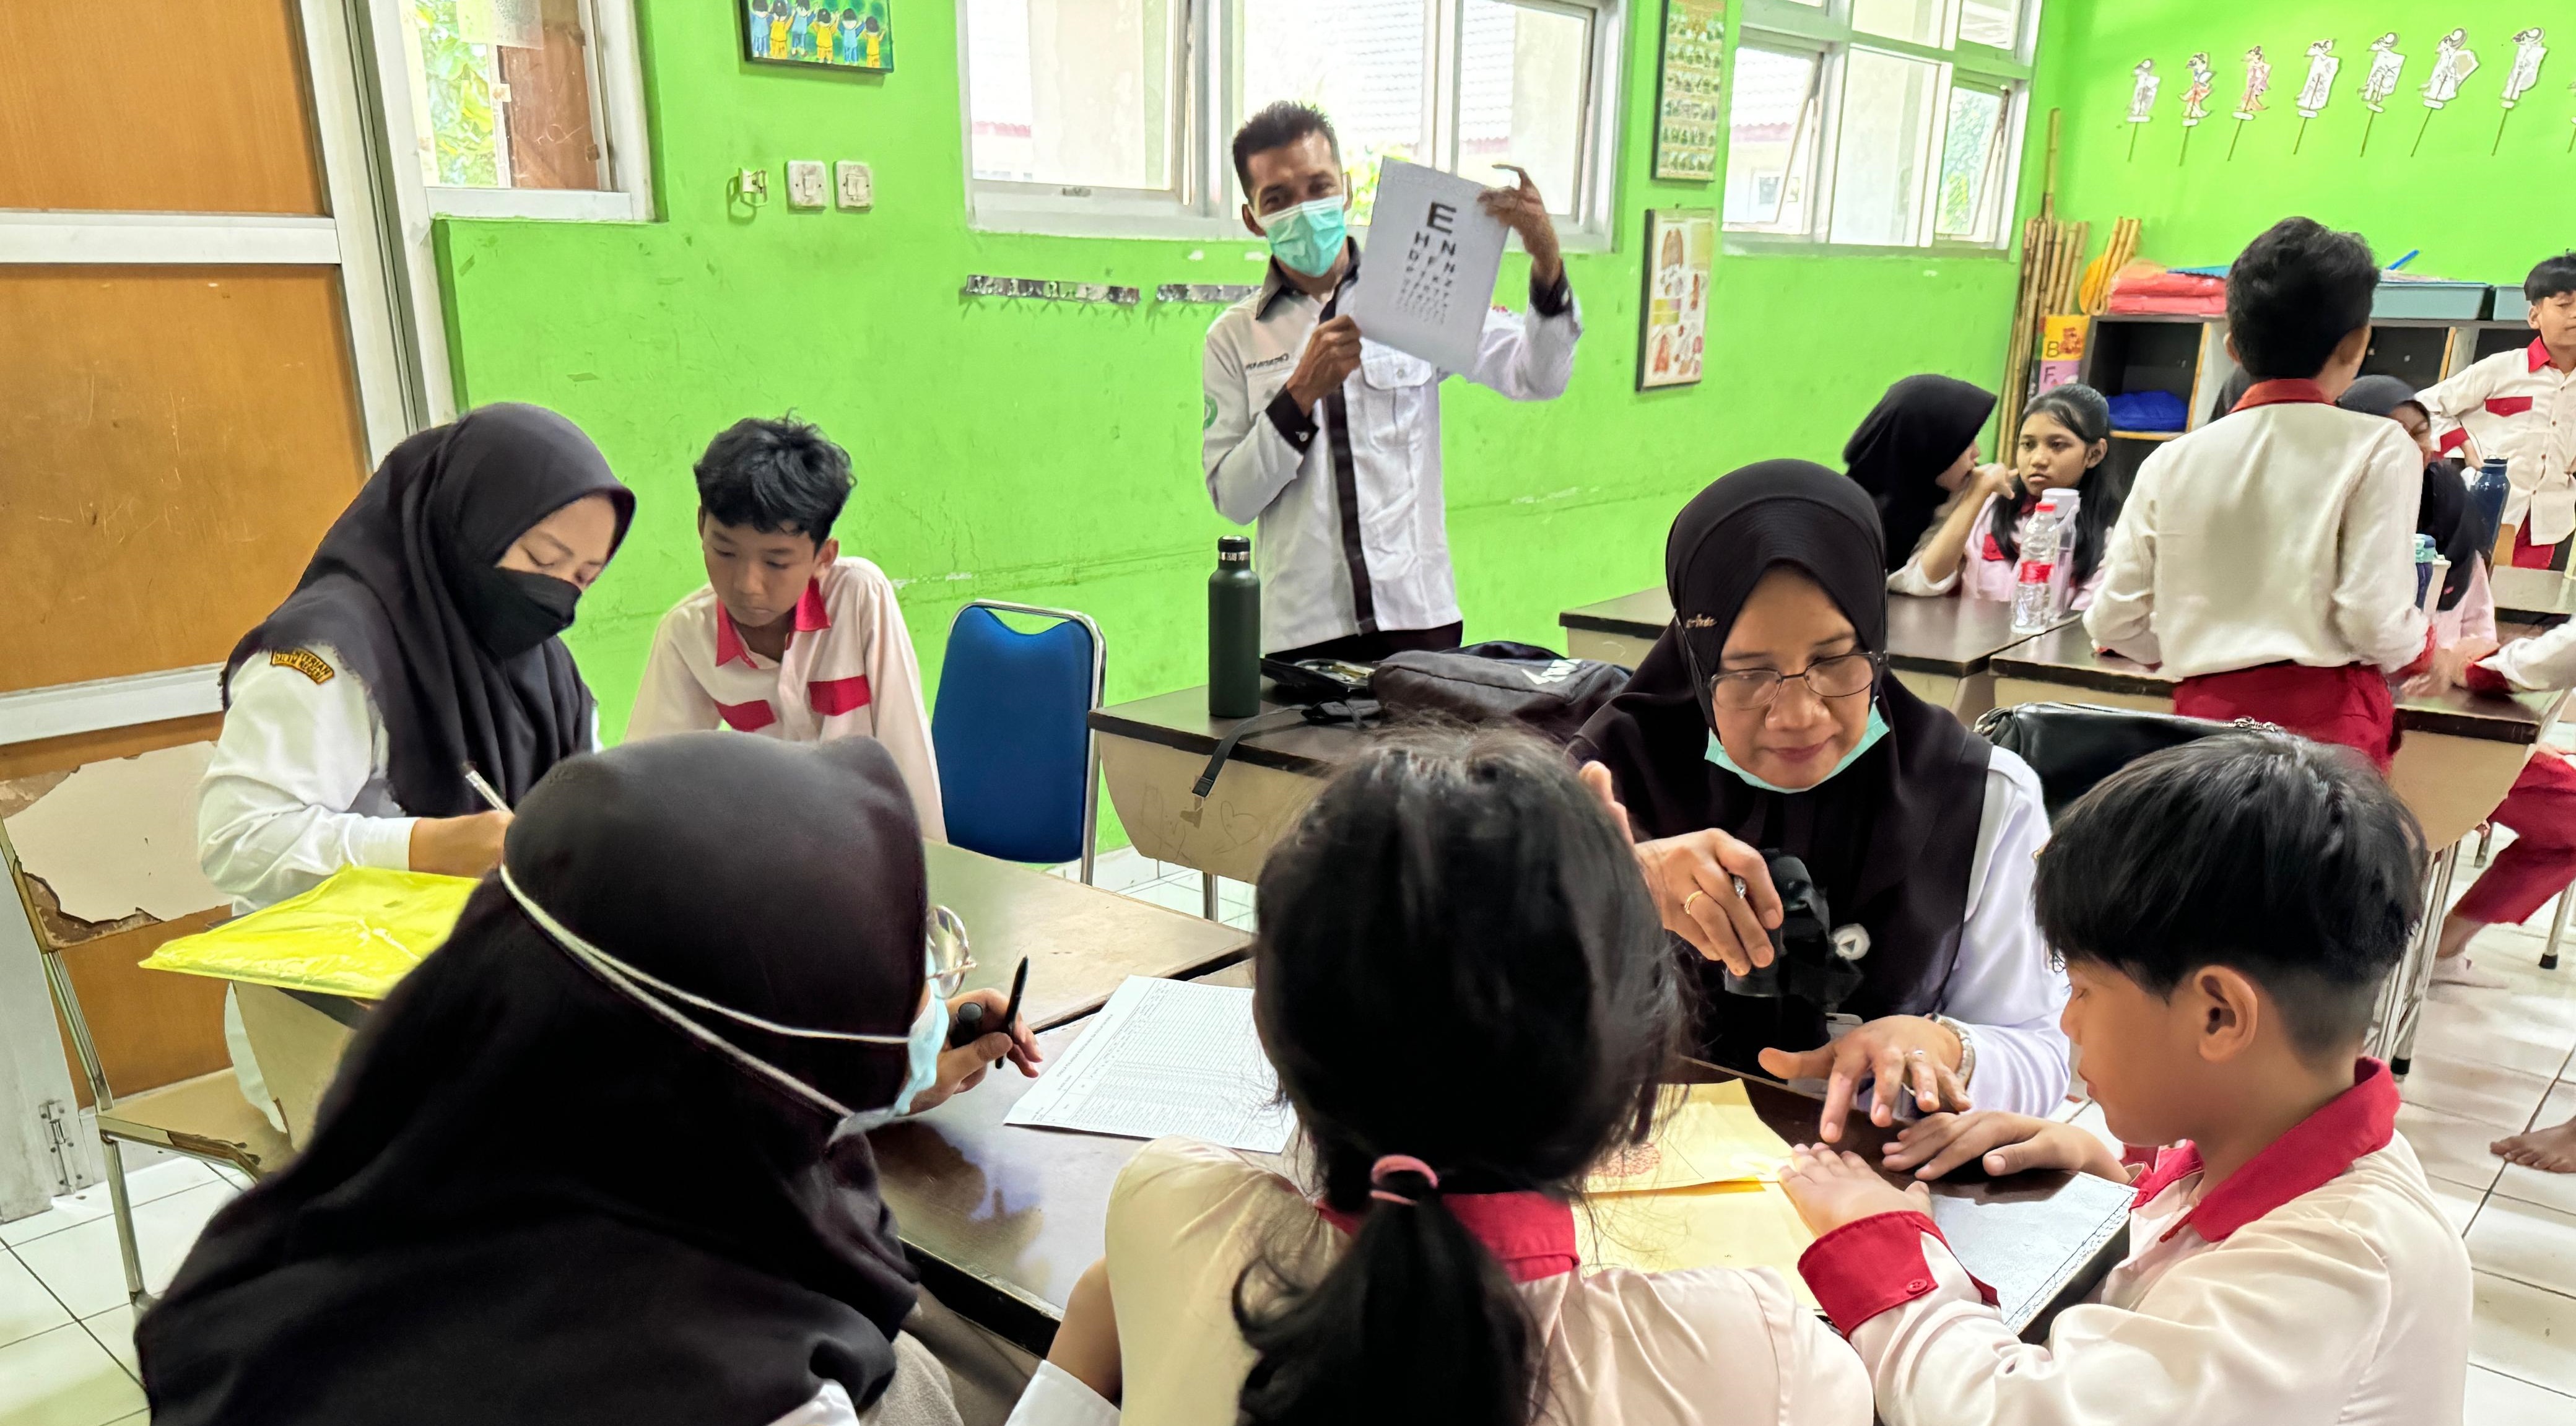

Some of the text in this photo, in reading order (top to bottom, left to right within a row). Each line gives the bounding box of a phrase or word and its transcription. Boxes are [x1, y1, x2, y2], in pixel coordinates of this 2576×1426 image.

[1427, 202, 1457, 234] E
[1414, 231, 1456, 256] H N
[2046, 341, 2060, 358] B
[2043, 366, 2056, 383] F
